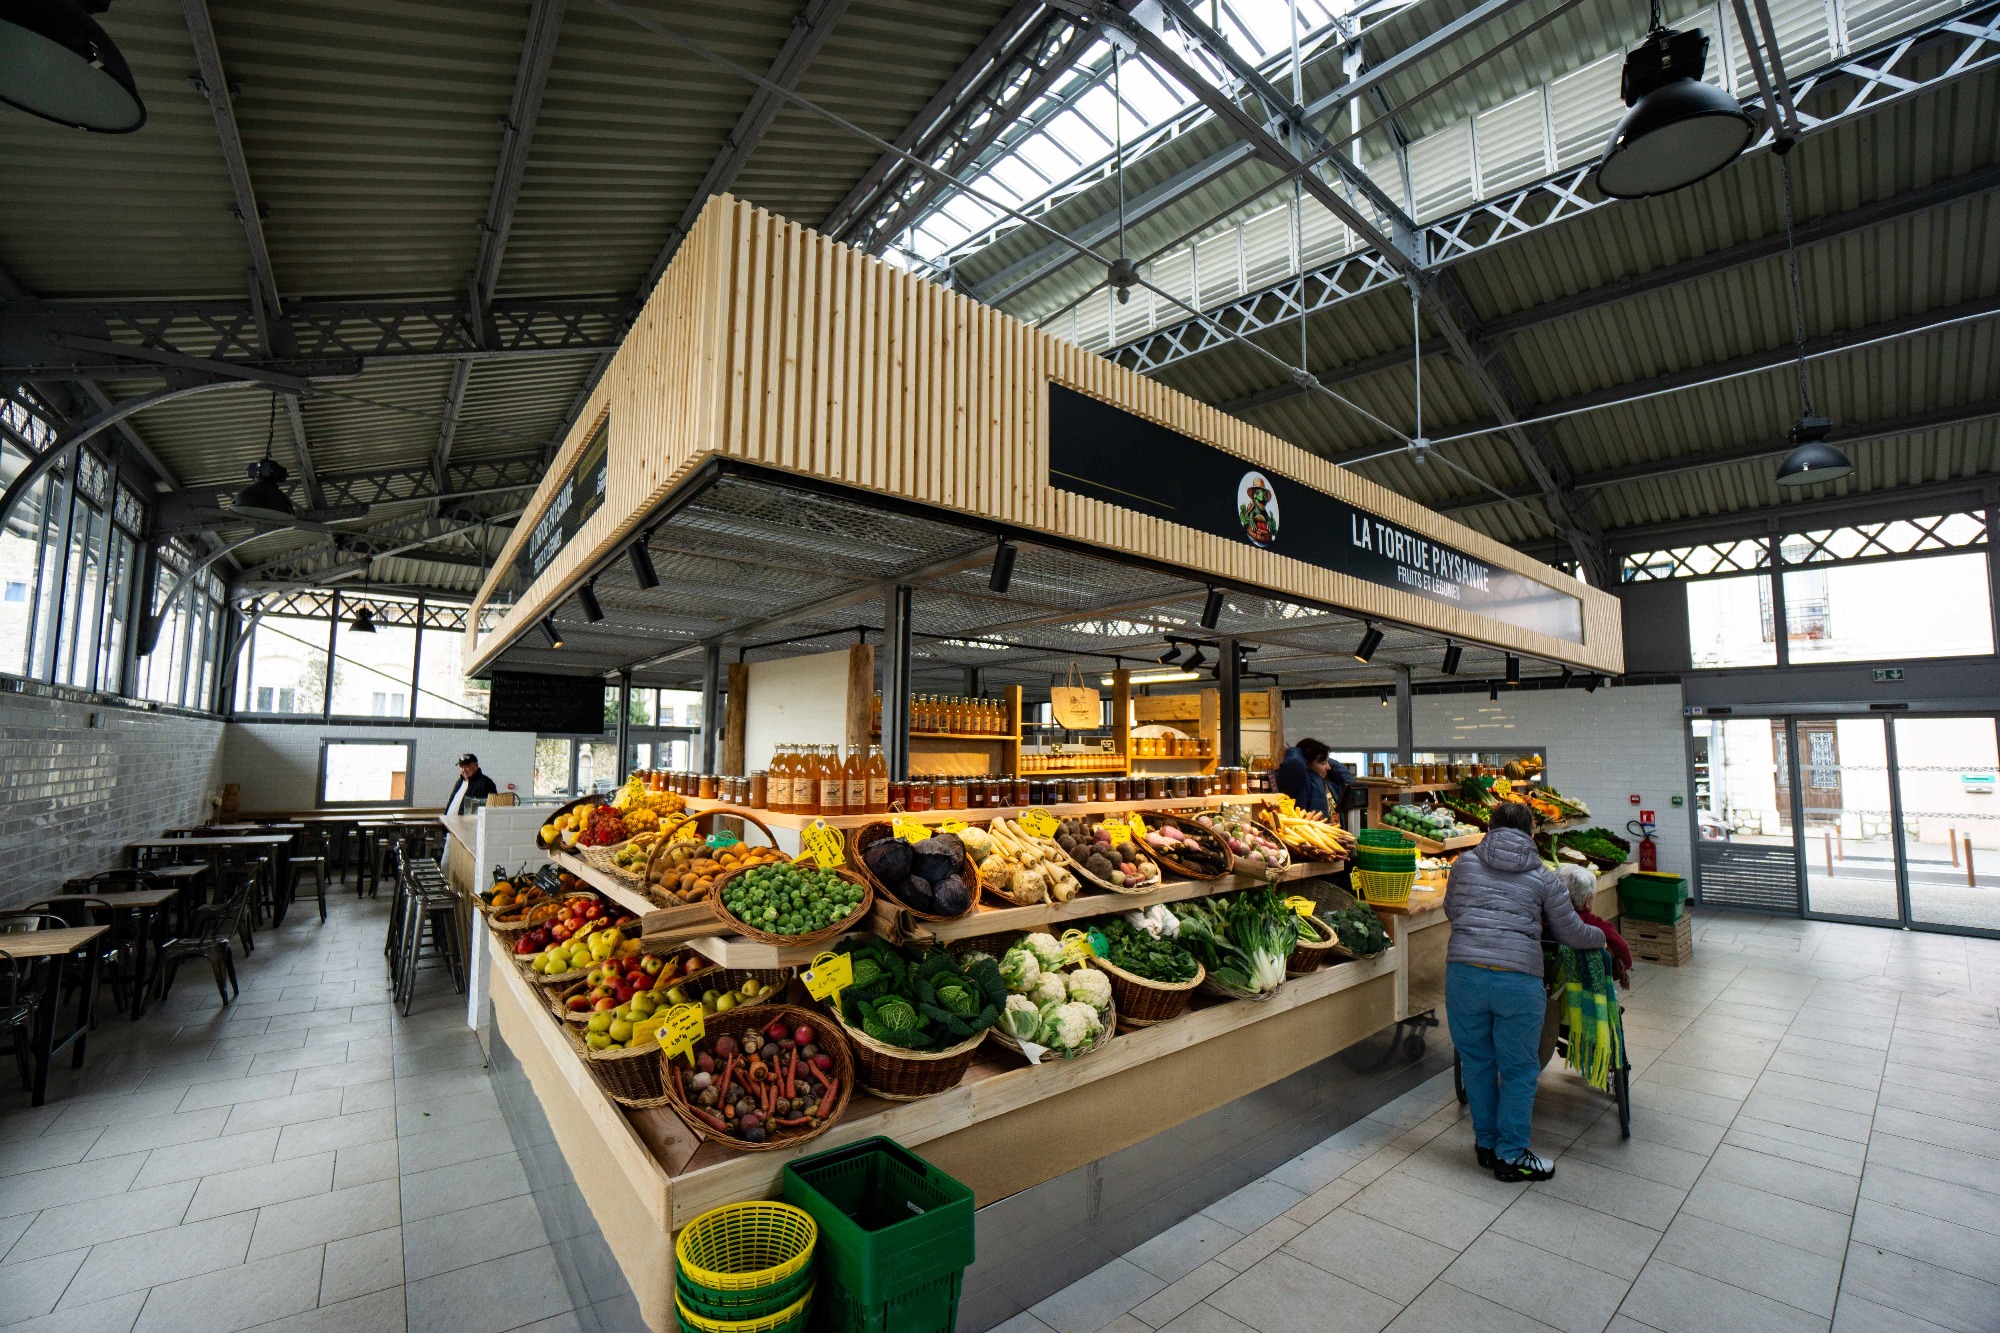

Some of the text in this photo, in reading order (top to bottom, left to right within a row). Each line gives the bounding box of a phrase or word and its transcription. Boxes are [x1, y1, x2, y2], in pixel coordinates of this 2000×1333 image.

[1352, 513, 1490, 593] LA TORTUE PAYSANNE
[1397, 565, 1461, 601] FRUITS ET LÉGUMES
